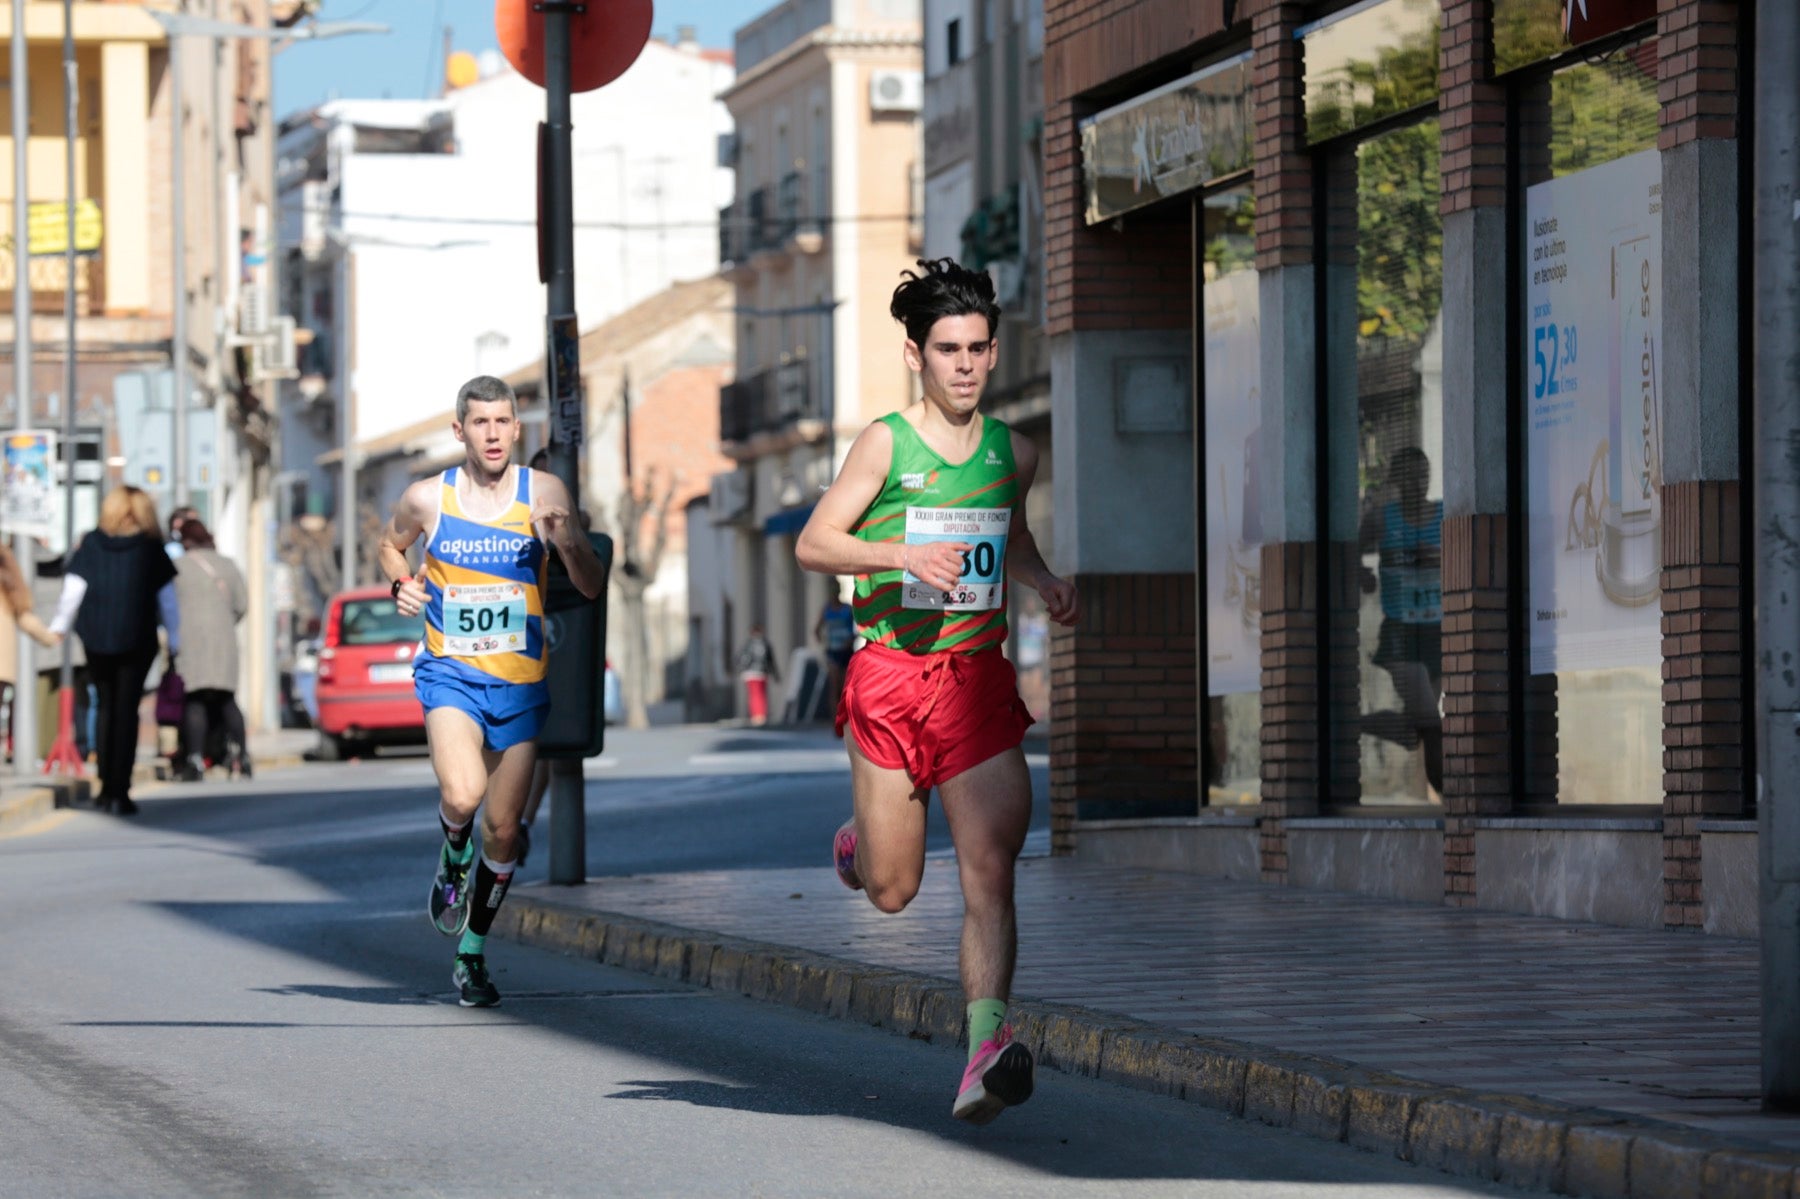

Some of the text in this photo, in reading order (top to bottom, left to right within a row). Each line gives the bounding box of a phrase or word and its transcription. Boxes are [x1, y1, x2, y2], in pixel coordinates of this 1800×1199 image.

[1533, 247, 1543, 261] con
[1543, 241, 1548, 258] lo
[1533, 270, 1540, 285] en
[1641, 259, 1651, 500] Note10+ 5G
[935, 511, 953, 521] GRAN
[977, 512, 986, 522] DE
[987, 512, 1007, 522] FONDO
[943, 522, 981, 533] DIPUTACIÓN
[440, 535, 531, 558] agustinos
[453, 554, 520, 564] GRANADA
[459, 606, 509, 632] 501
